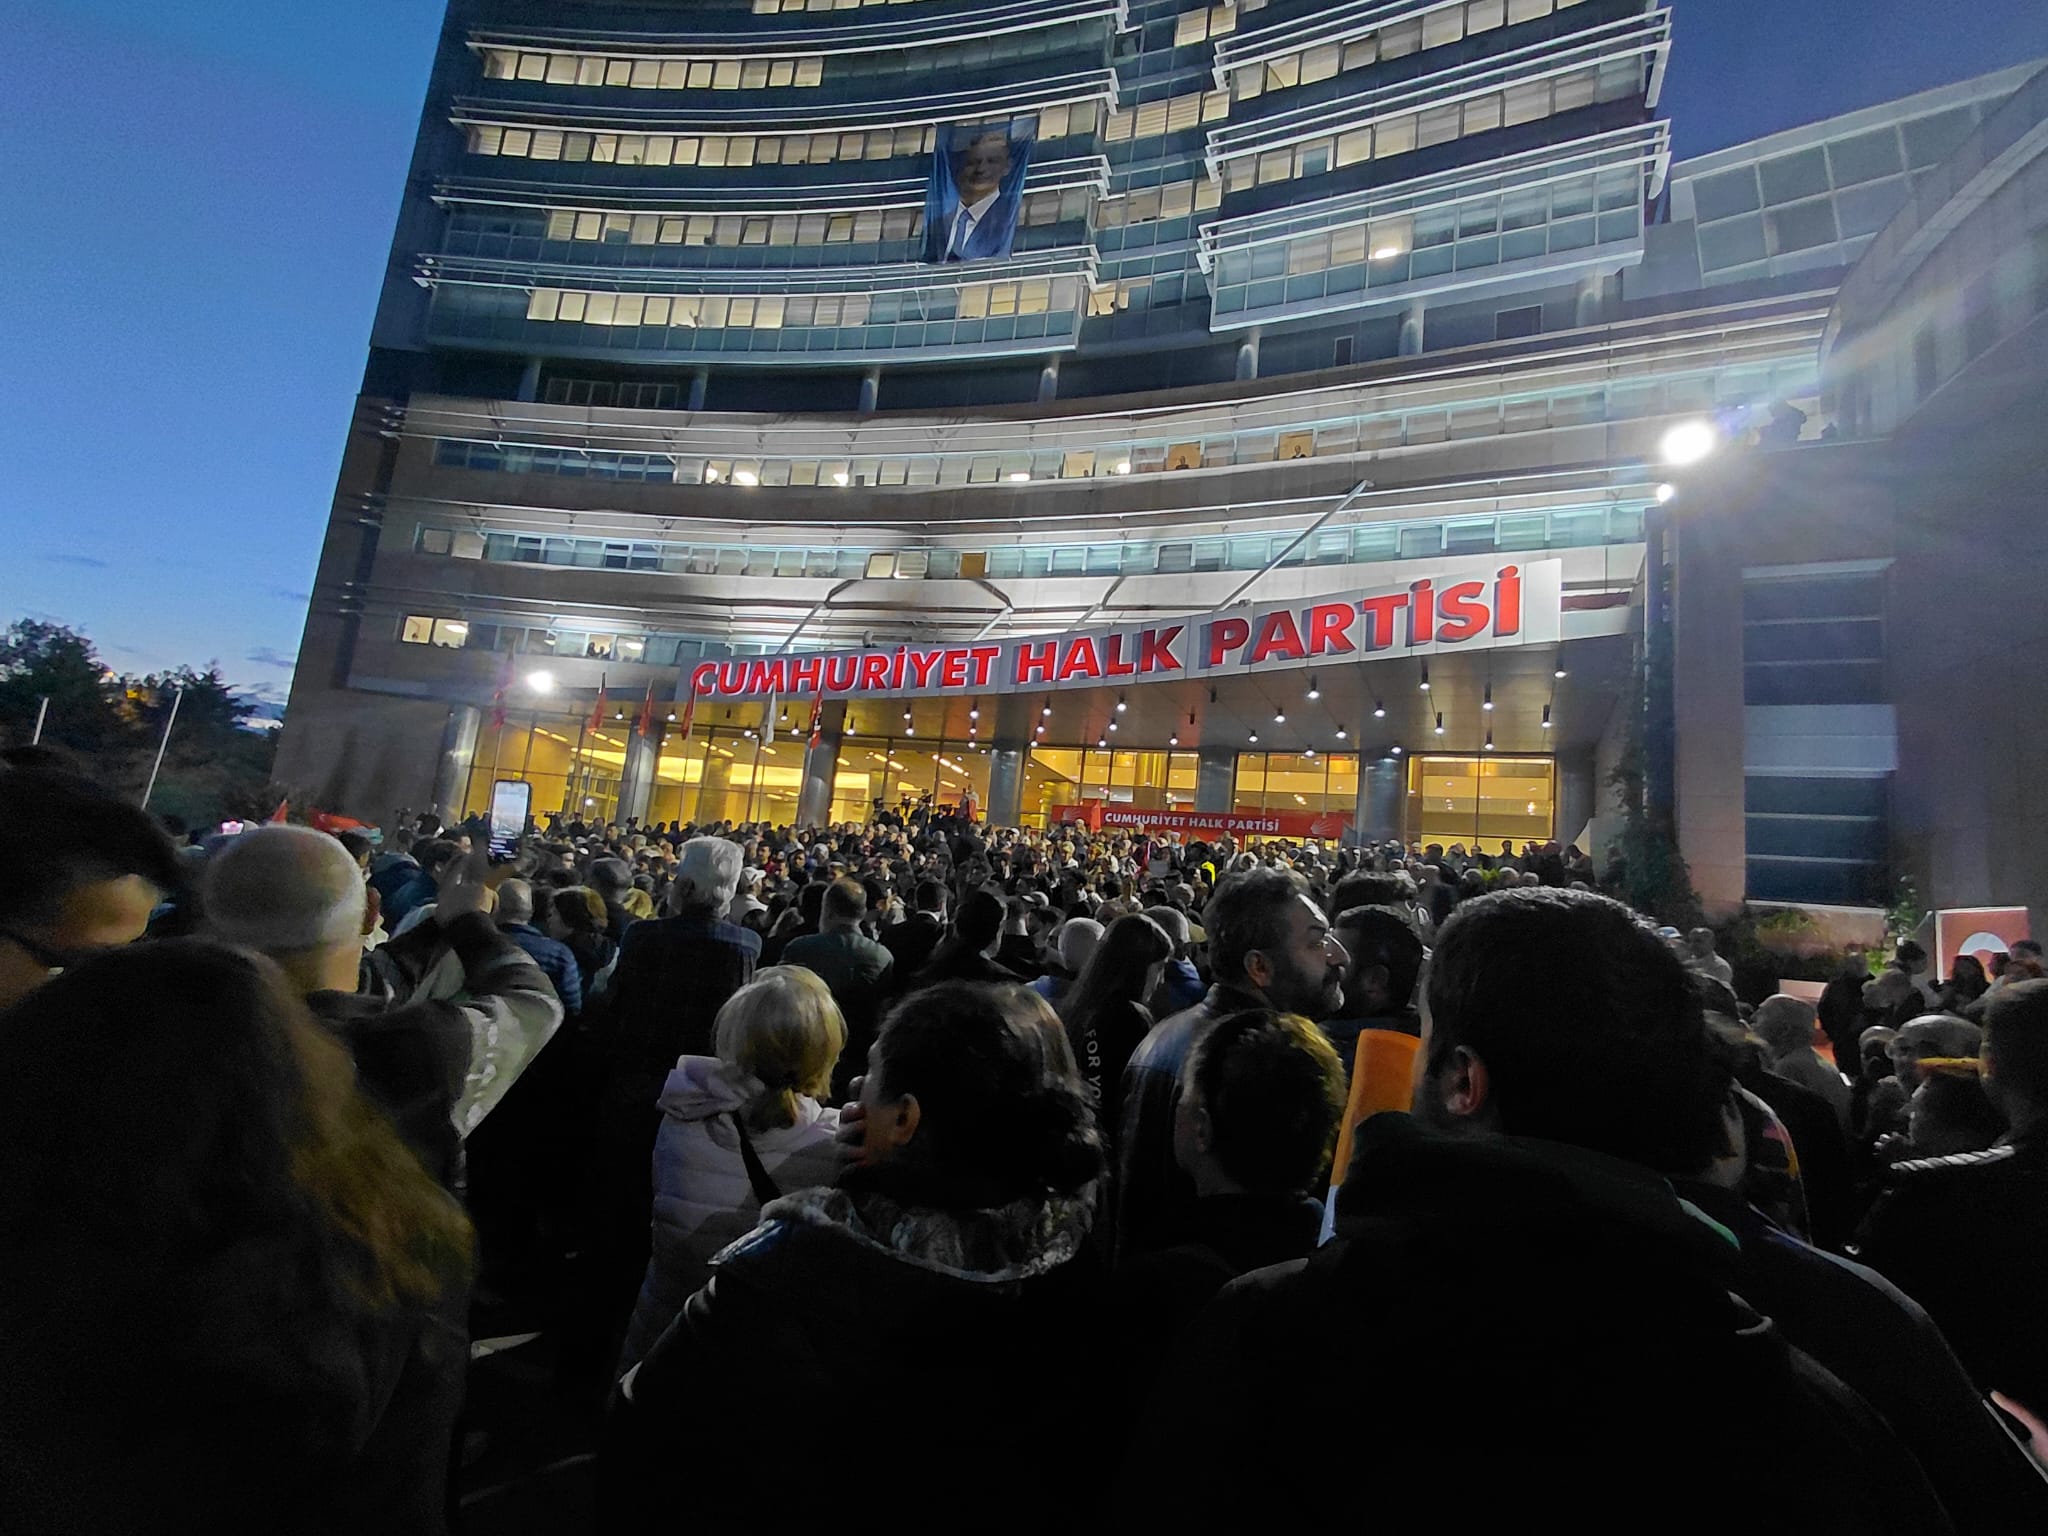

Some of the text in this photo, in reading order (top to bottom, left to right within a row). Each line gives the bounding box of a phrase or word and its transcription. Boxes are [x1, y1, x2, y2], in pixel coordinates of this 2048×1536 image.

[691, 565, 1520, 695] CUMHURİYET HALK PARTİSİ
[1105, 812, 1280, 832] CUMHURİYET HALK PARTİSİ
[1086, 1028, 1101, 1067] FOR
